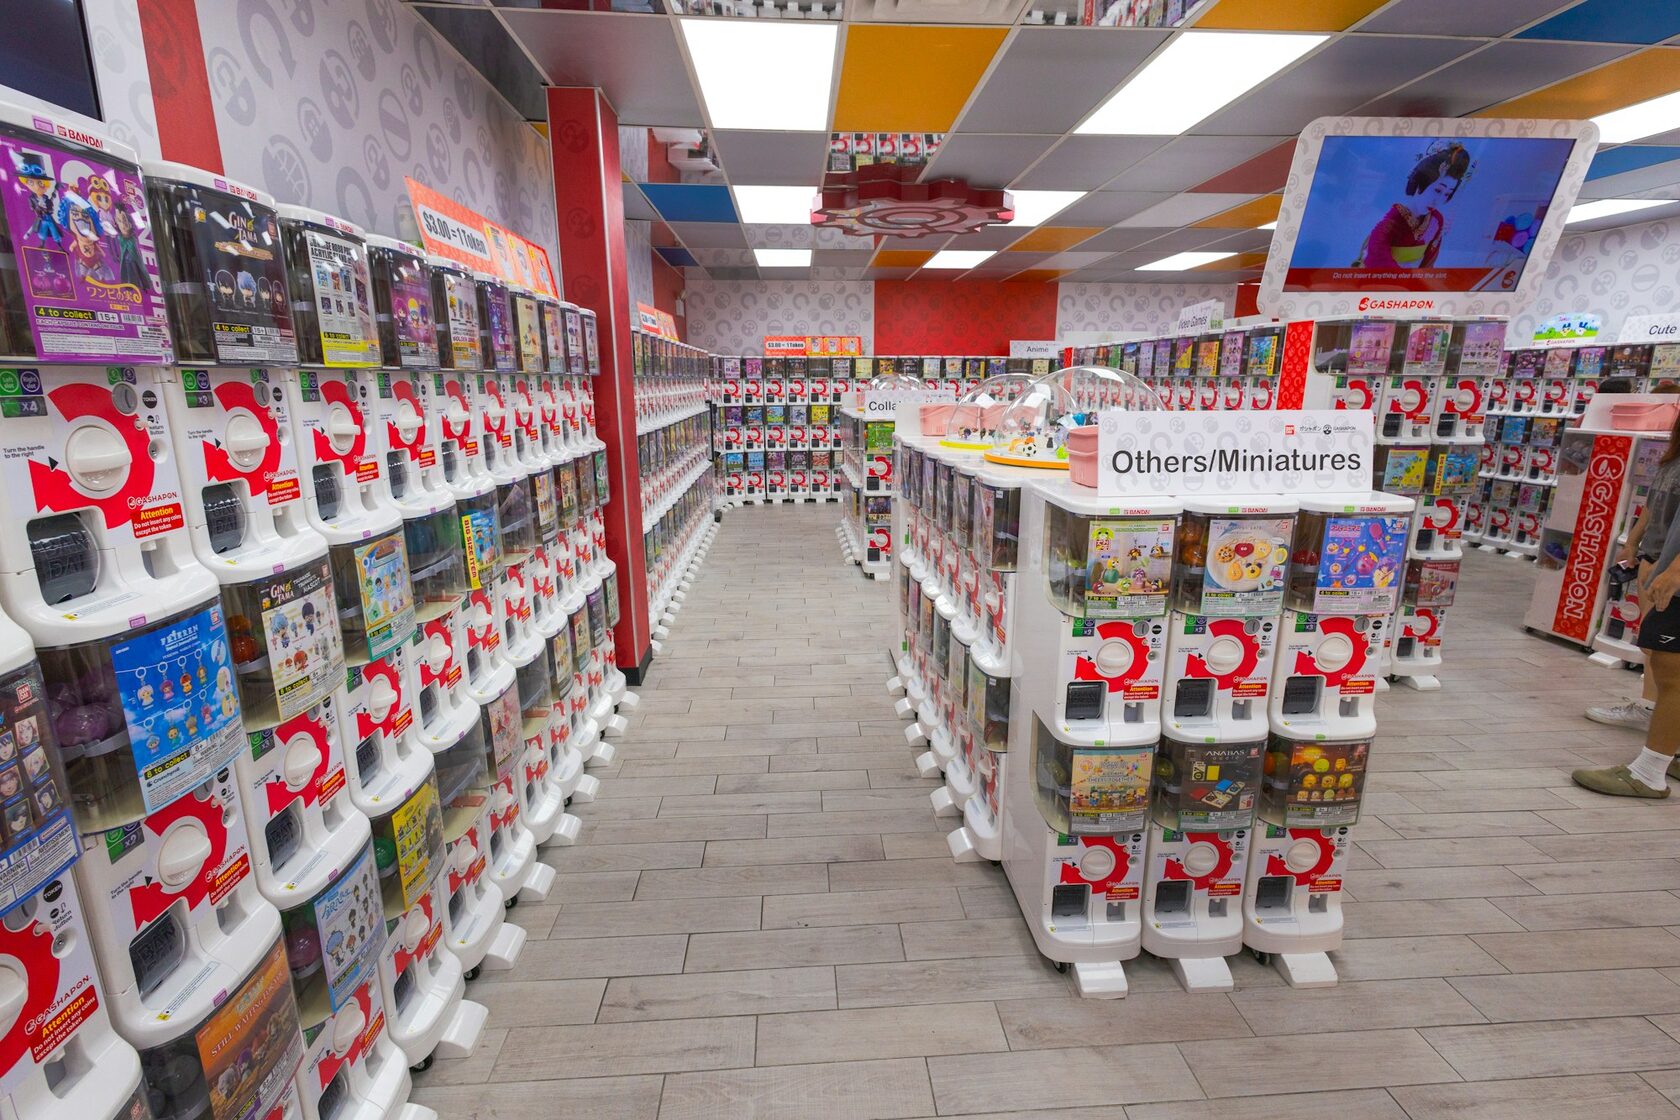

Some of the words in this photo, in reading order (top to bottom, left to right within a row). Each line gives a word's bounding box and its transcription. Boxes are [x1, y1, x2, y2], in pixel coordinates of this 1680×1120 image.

[67, 129, 104, 150] BANDAI
[422, 210, 452, 241] $3.00
[1372, 272, 1397, 281] anything
[1370, 300, 1433, 309] GASHAPON
[38, 308, 45, 316] 4
[48, 308, 59, 318] to
[63, 310, 93, 320] collect
[100, 313, 117, 321] 15+
[1190, 316, 1208, 328] Games
[1648, 324, 1678, 336] Cute
[198, 396, 208, 405] x3
[1112, 448, 1362, 474] Others/Miniatures
[272, 482, 294, 491] Attention
[136, 492, 178, 505] GASHAPON
[140, 507, 174, 521] Attention
[134, 522, 142, 530] Do
[150, 518, 163, 527] insert
[163, 517, 171, 525] any
[135, 528, 151, 537] except
[151, 526, 159, 534] the
[159, 524, 172, 532] token
[1564, 479, 1613, 620] GASHAPON
[293, 677, 308, 689] collect
[154, 766, 163, 775] to
[165, 752, 188, 768] collect
[215, 860, 242, 887] Attention
[44, 884, 62, 899] TOKEN
[36, 975, 89, 1025] GASHAPON
[42, 997, 85, 1038] Attention
[34, 1043, 44, 1054] Do
[43, 1034, 54, 1045] not
[54, 1019, 71, 1035] insert
[70, 1010, 81, 1022] any
[82, 997, 96, 1011] coins
[36, 1041, 56, 1061] except
[56, 1032, 67, 1043] the
[66, 1016, 83, 1033] token
[210, 1034, 234, 1057] STILL
